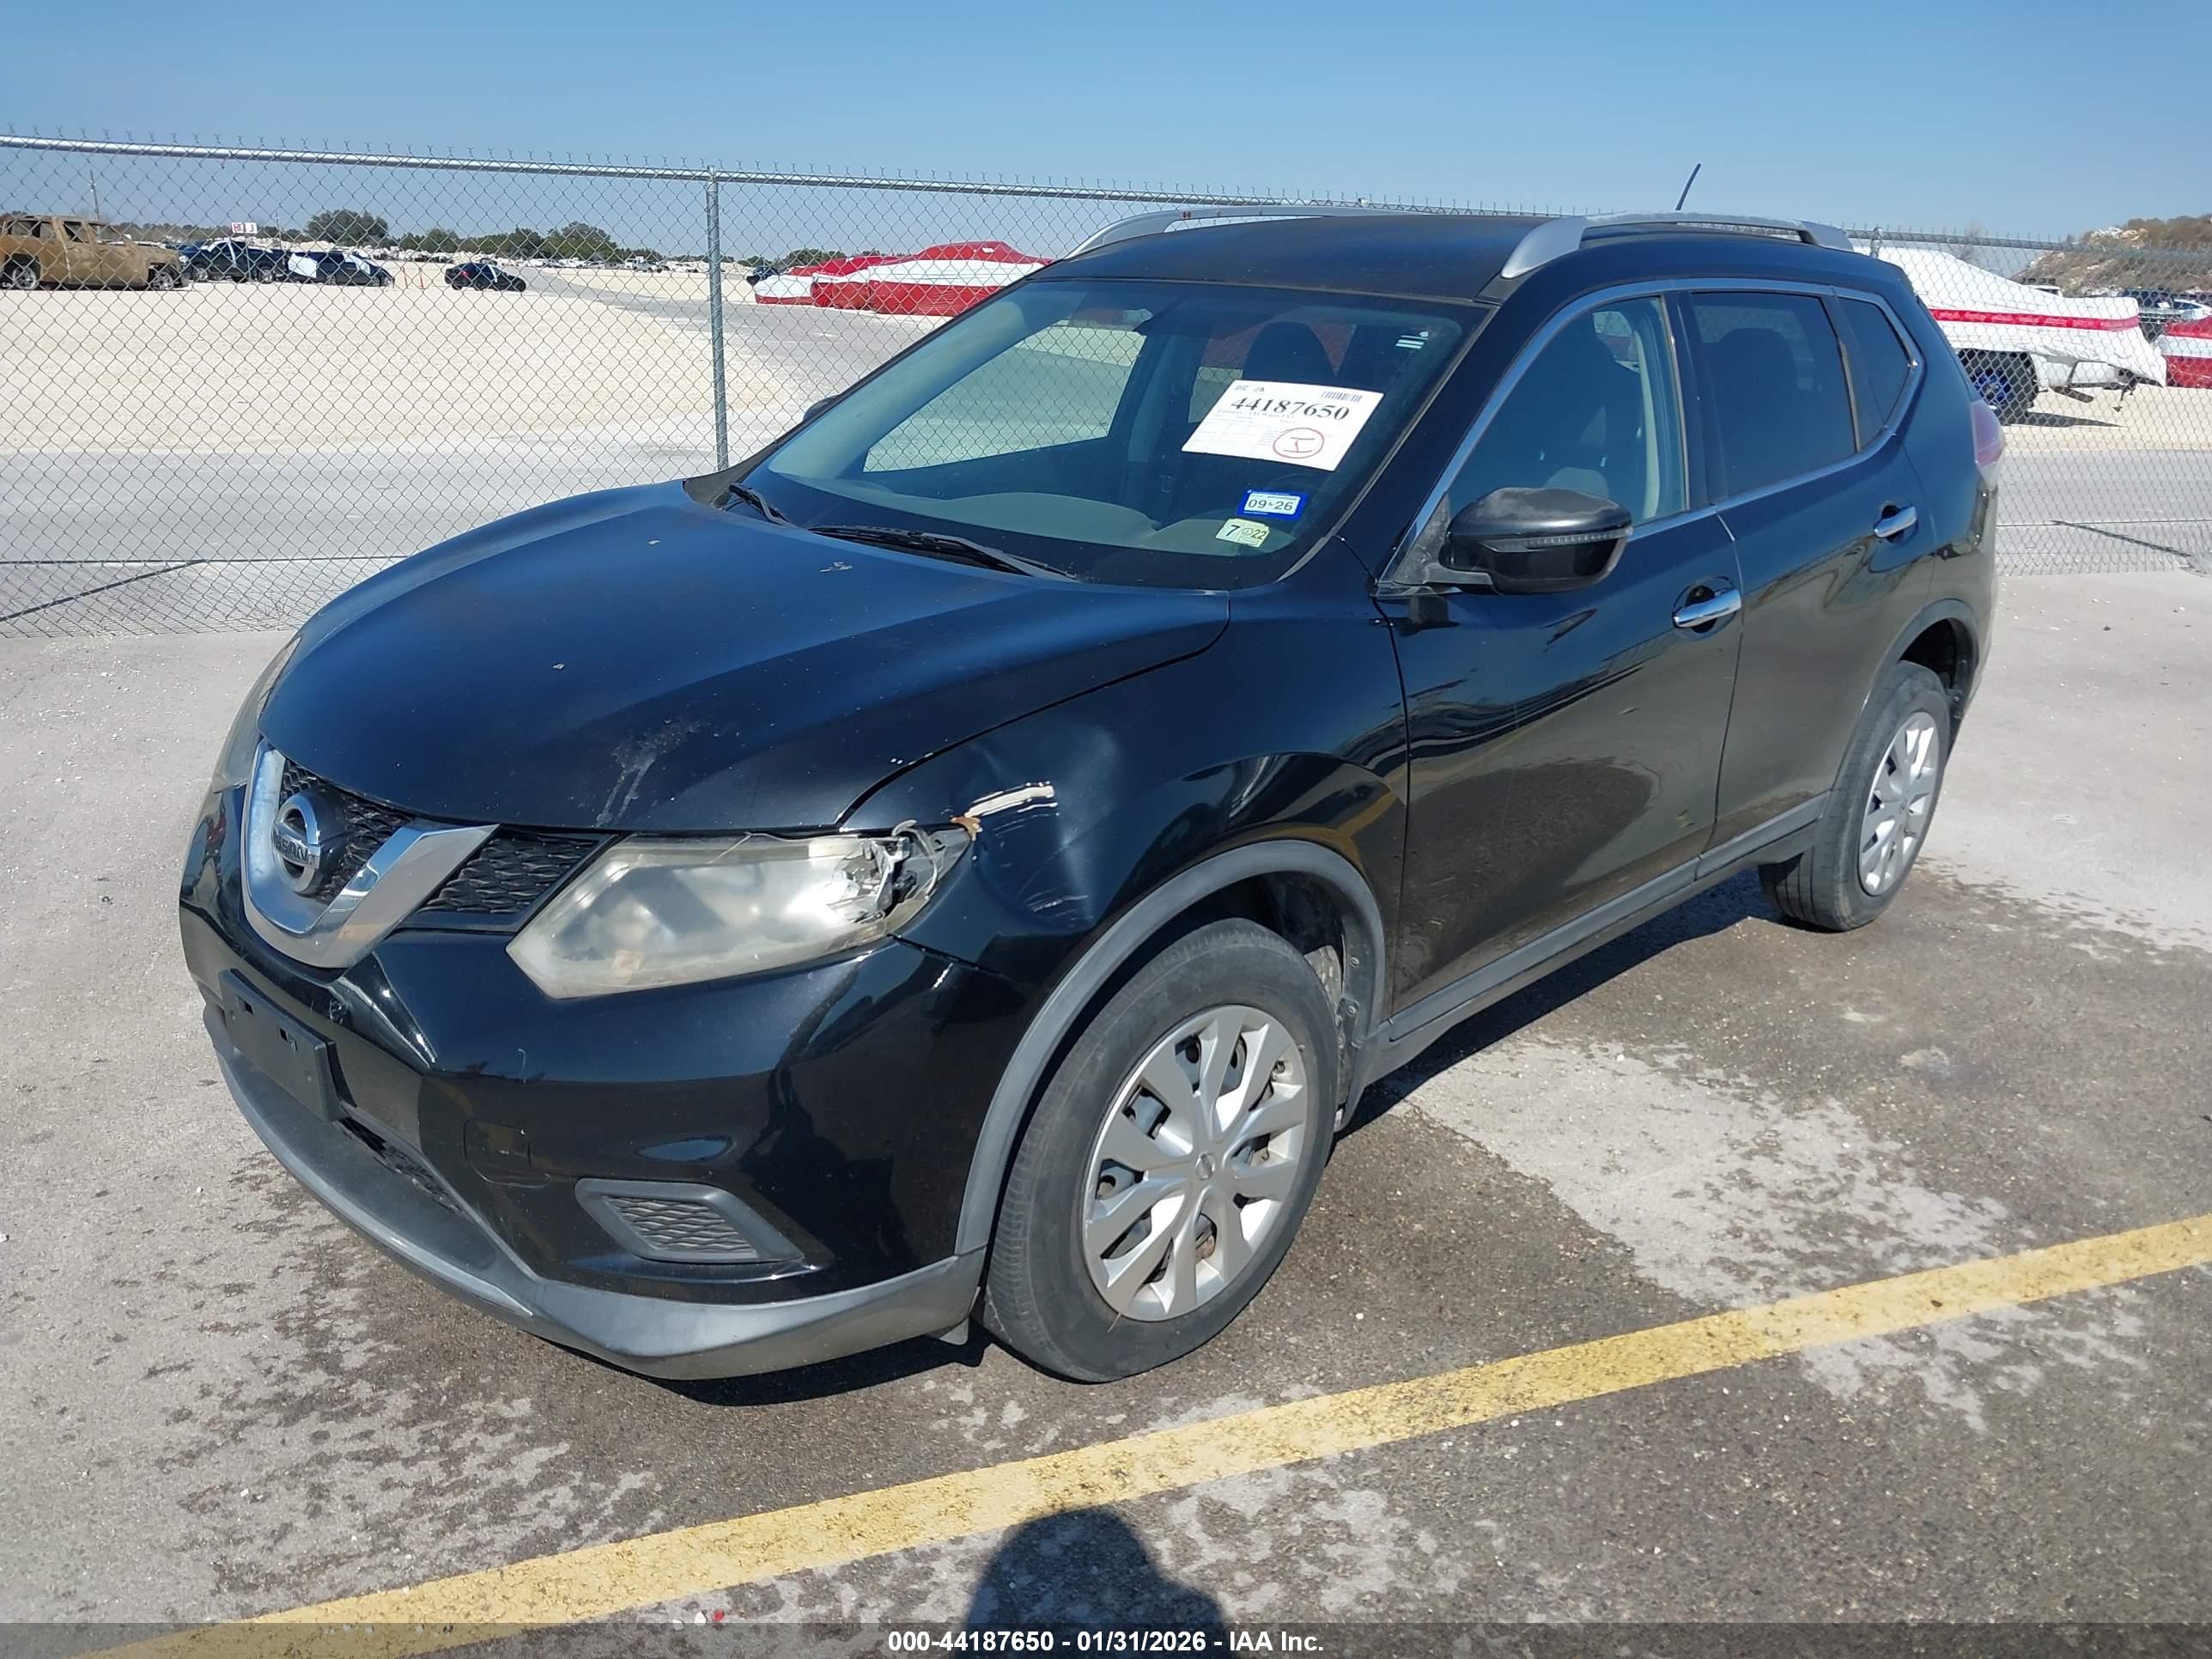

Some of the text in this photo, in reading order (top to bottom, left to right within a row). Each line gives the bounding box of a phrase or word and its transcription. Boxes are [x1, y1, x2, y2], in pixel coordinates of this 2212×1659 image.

[1231, 397, 1350, 421] 44187650
[1248, 499, 1295, 511] 09 26
[1225, 525, 1267, 540] 7 22
